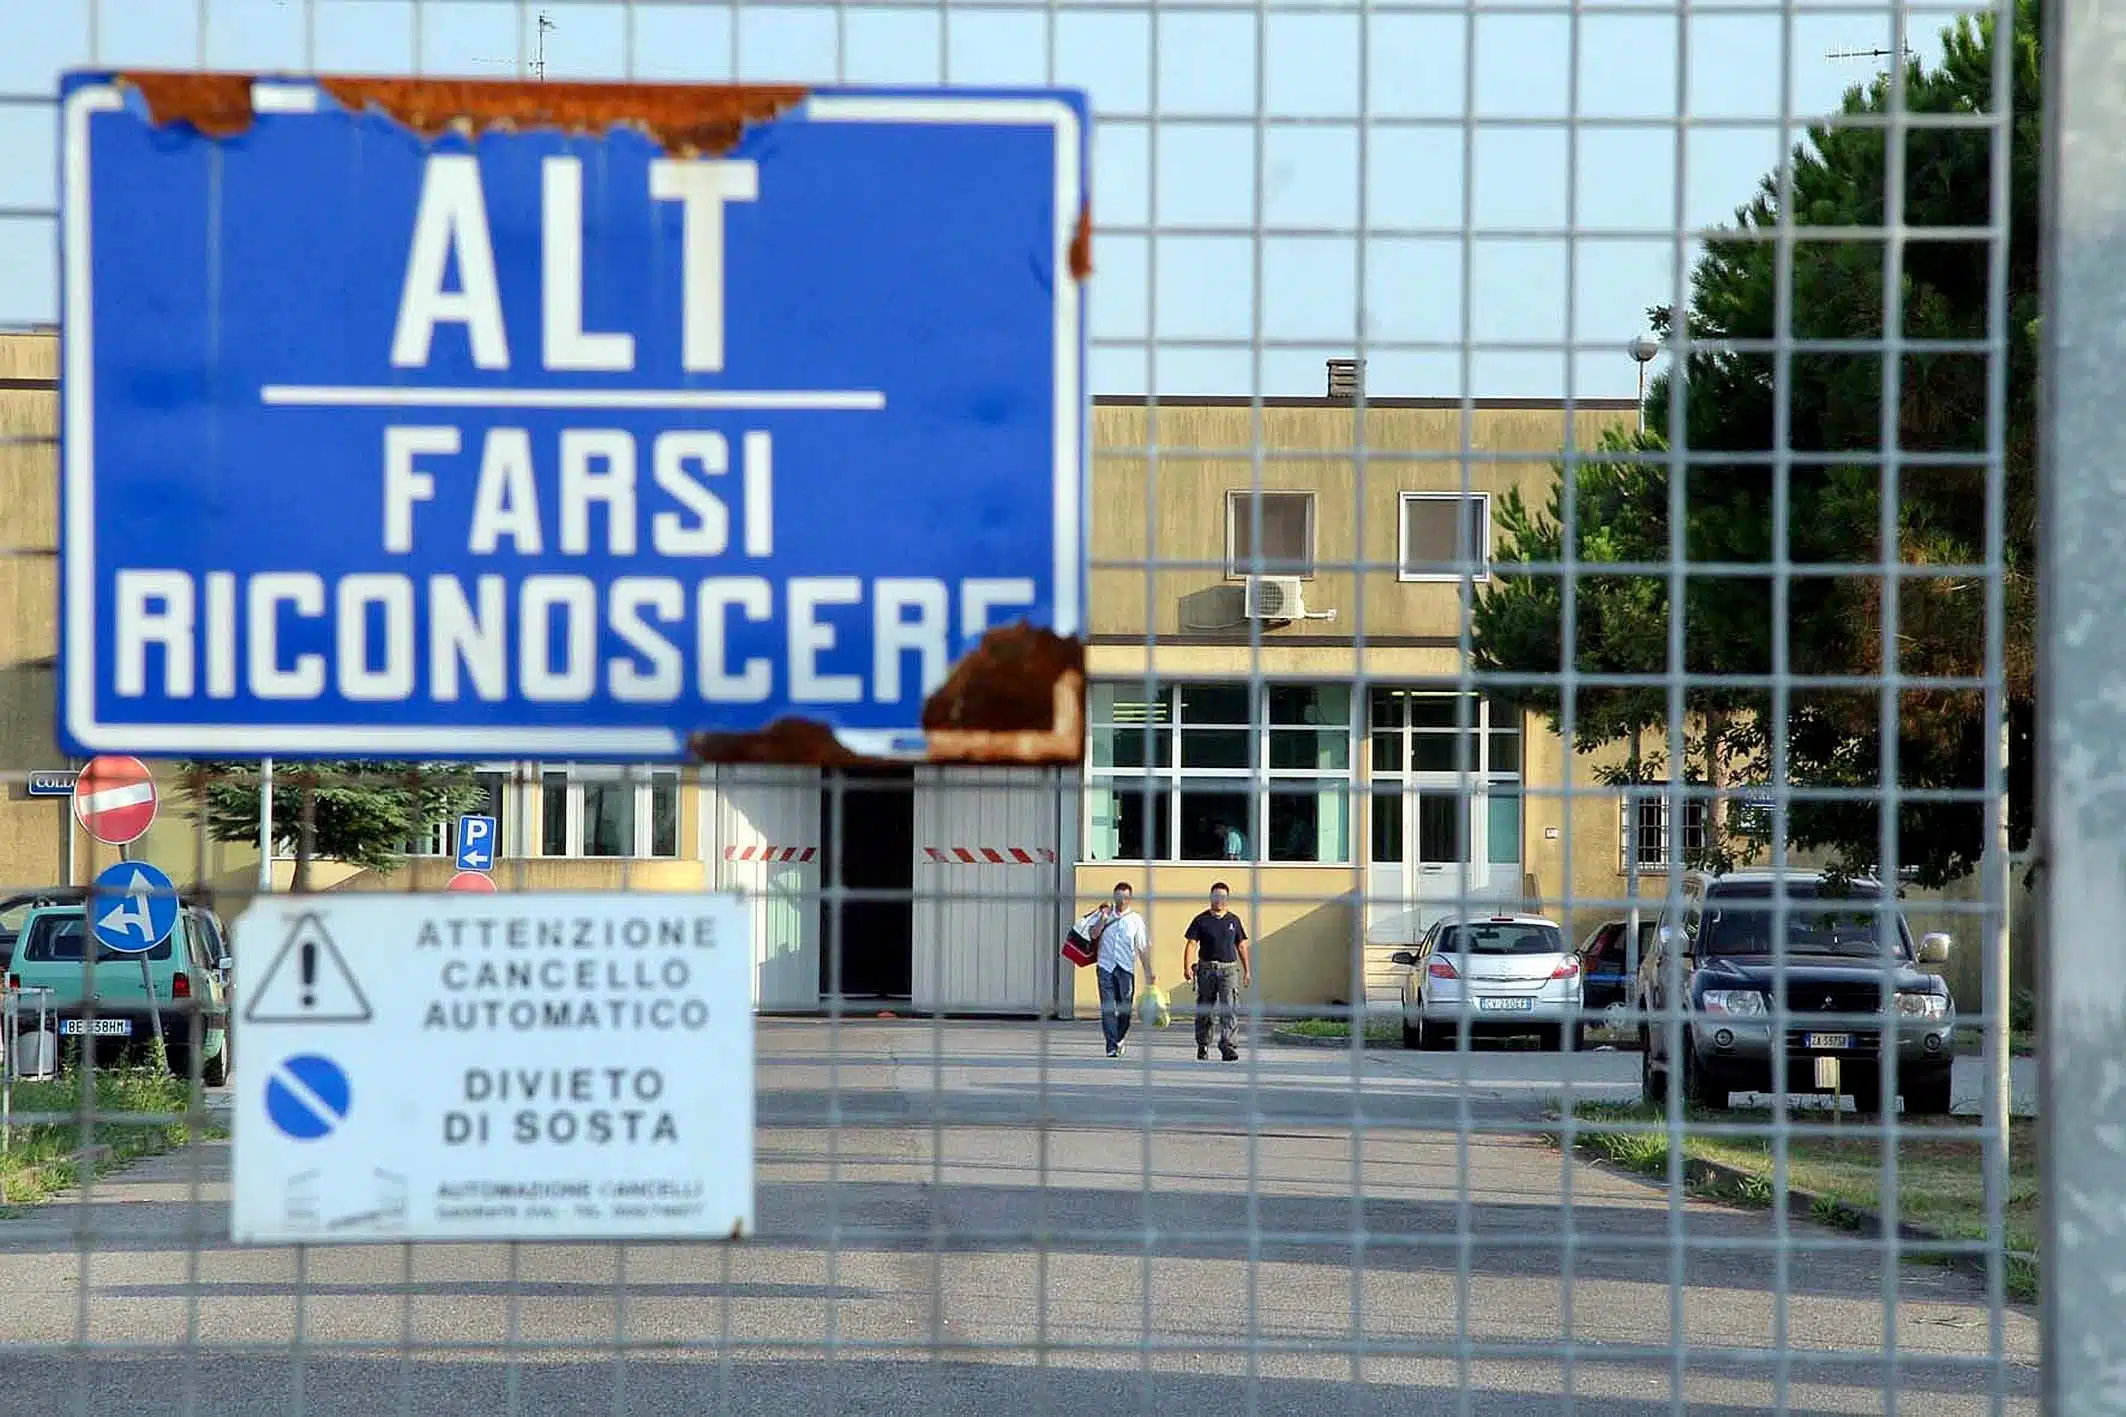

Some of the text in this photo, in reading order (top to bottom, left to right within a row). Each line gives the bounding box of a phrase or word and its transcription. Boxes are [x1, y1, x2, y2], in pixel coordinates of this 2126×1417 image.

[391, 155, 759, 373] ALT
[383, 426, 773, 557] FARSI
[466, 820, 488, 846] P
[416, 917, 717, 949] ATTENZIONE
[441, 957, 691, 991] CANCELLO
[423, 999, 711, 1031] AUTOMATICO
[464, 1067, 664, 1102] DIVIETO
[443, 1109, 679, 1144] DI SOSTA
